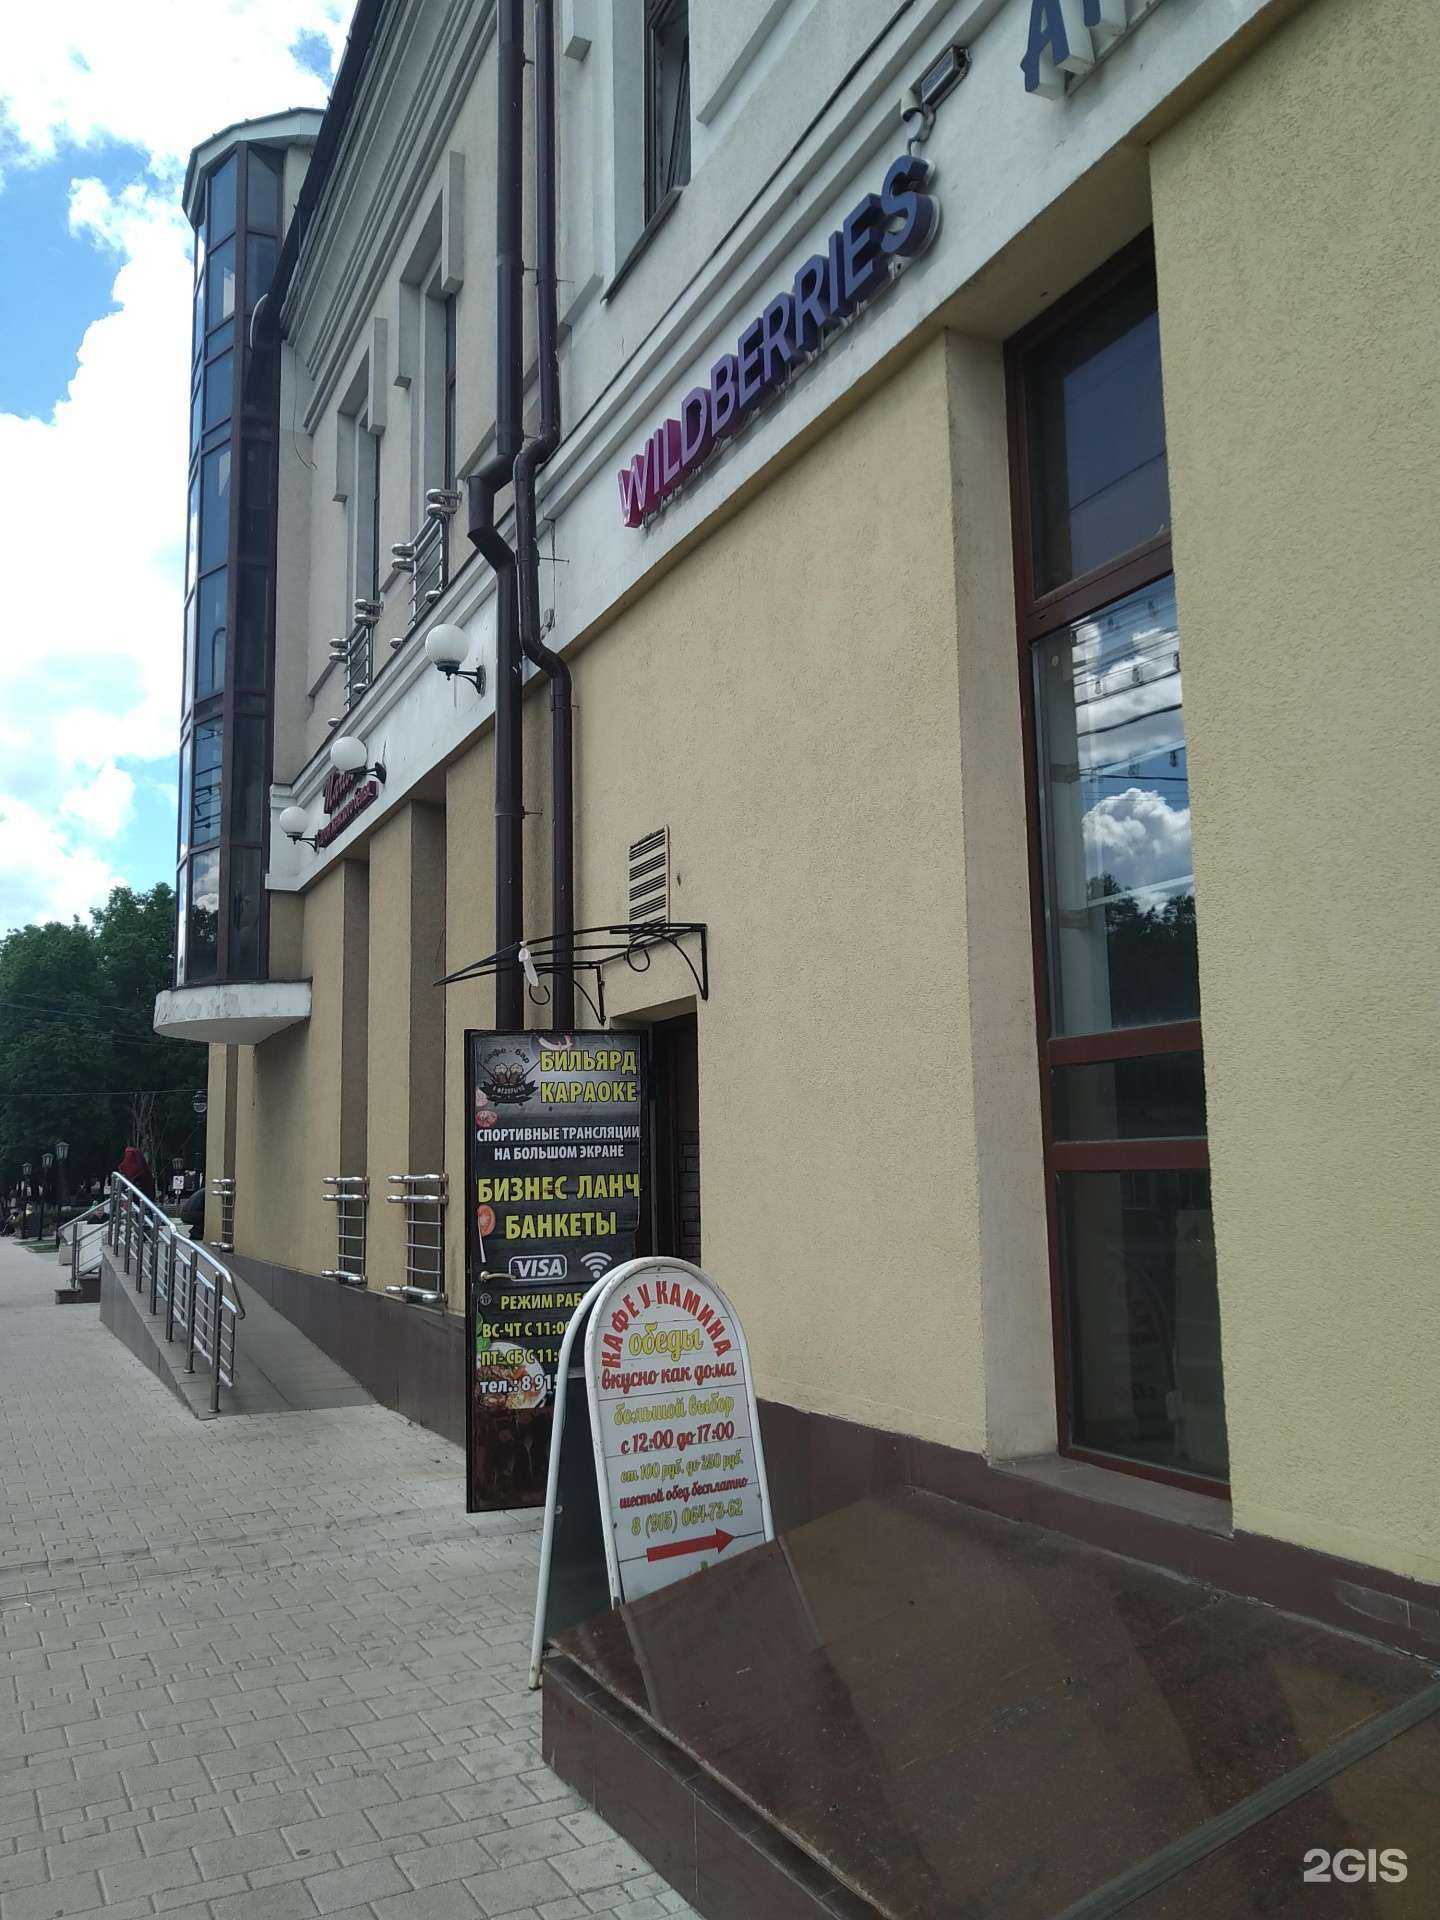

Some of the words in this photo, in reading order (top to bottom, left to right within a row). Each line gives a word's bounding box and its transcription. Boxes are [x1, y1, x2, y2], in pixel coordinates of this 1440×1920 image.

[1020, 0, 1108, 95] А
[617, 155, 942, 528] WILDBERRIES
[540, 1050, 638, 1075] БИЛЬЯРД
[540, 1081, 638, 1103] КАРАОКЕ
[476, 1127, 560, 1142] СПОРТИВНЫЕ
[562, 1125, 640, 1141] ТРАНСЛЯЦИИ
[494, 1147, 511, 1161] НА
[513, 1145, 578, 1160] БОЛЬШОМ
[579, 1144, 624, 1158] ЭКРАНЕ
[477, 1175, 568, 1203] БИЗНЕС
[576, 1173, 640, 1199] ЛАНЧ
[505, 1211, 617, 1239] БАНКЕТЫ
[515, 1258, 563, 1278] VISA
[500, 1294, 553, 1310] РЕЖИМ
[556, 1292, 584, 1308] РАБ
[482, 1322, 522, 1338] ВС-ЧТ
[524, 1321, 533, 1336] С
[602, 1294, 640, 1368] КАФЕ
[637, 1284, 651, 1309] У
[656, 1280, 732, 1357] КАМИНА
[629, 1322, 704, 1361] обеды
[526, 1348, 535, 1364] С
[536, 1347, 561, 1363] 11:
[480, 1379, 518, 1393] тел.:
[521, 1375, 531, 1391] 8
[602, 1368, 659, 1394] вкусно
[661, 1366, 692, 1384] как
[694, 1362, 737, 1385] дома
[613, 1398, 688, 1426] большой
[688, 1391, 735, 1419] выбор
[620, 1440, 631, 1455] с
[632, 1429, 674, 1453] 12:00
[676, 1431, 696, 1451] до
[697, 1420, 735, 1443] 17:00
[620, 1469, 639, 1483] от
[640, 1462, 660, 1481] 100
[686, 1461, 702, 1476] до
[620, 1488, 664, 1509] шестой
[666, 1483, 690, 1503] обед
[691, 1476, 748, 1497] бесплатно
[631, 1516, 641, 1536] 8
